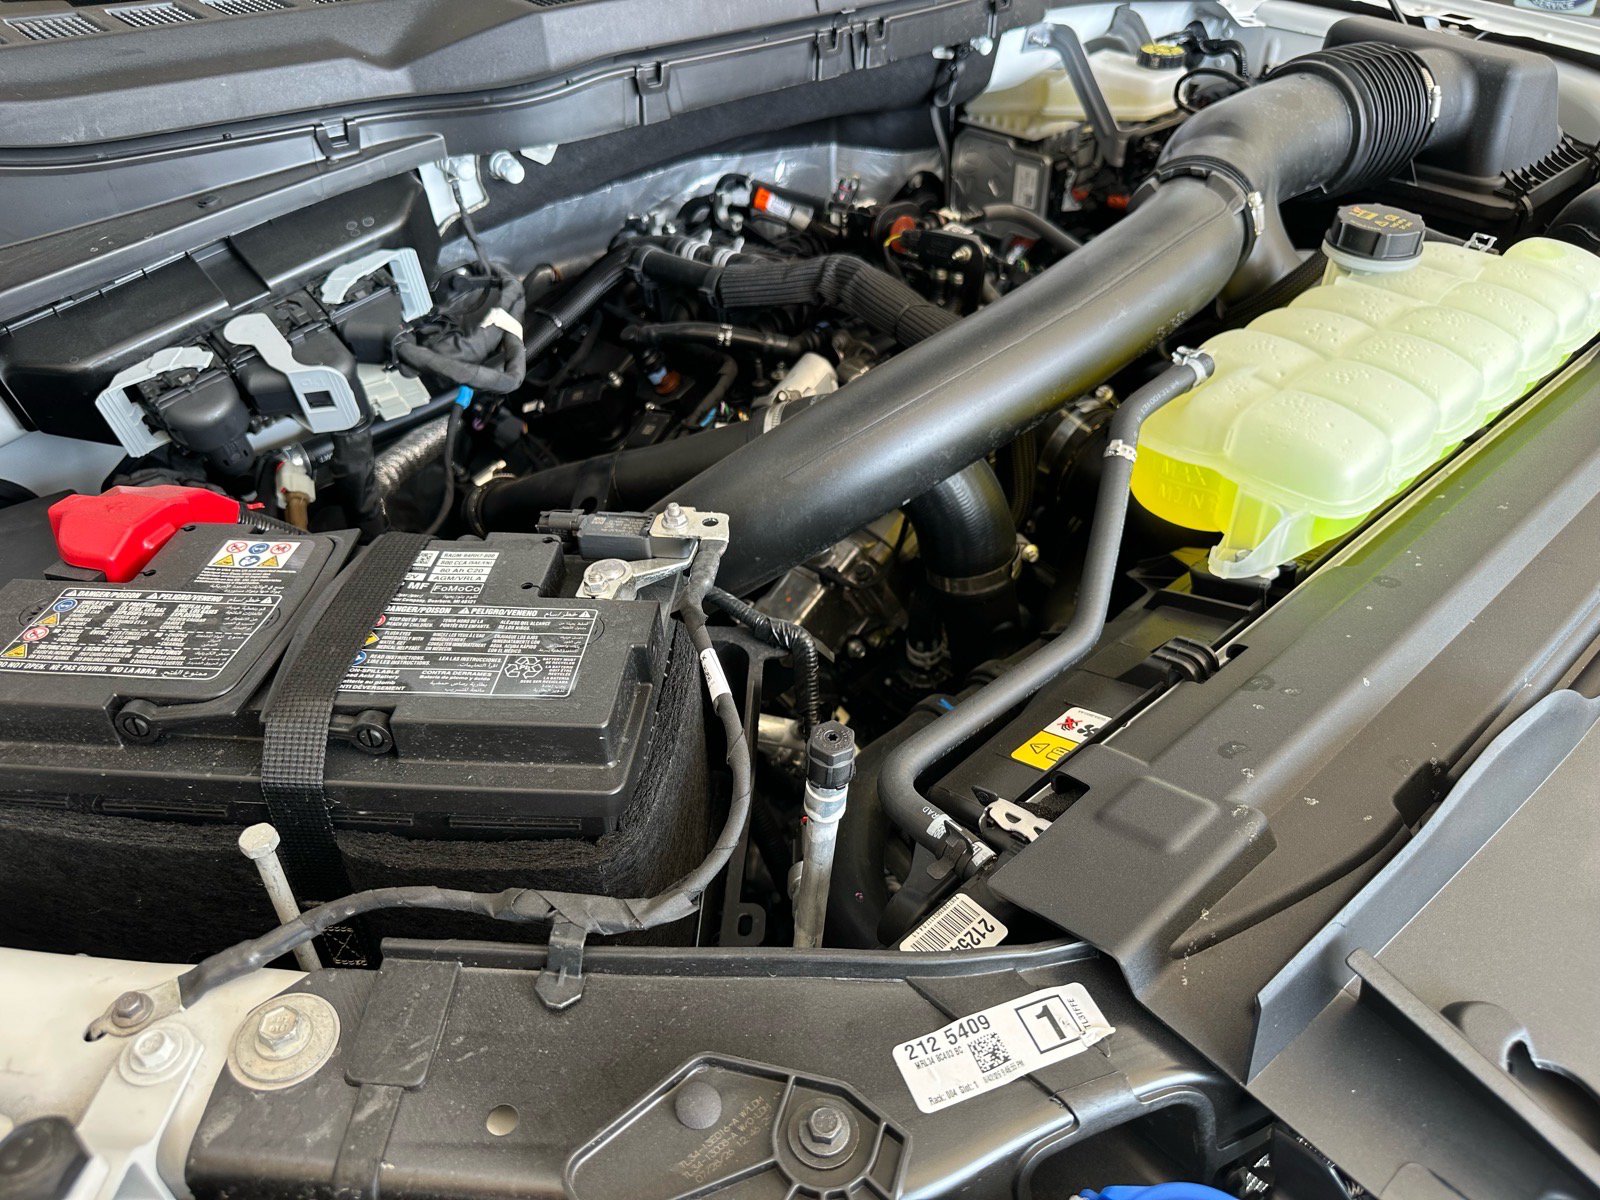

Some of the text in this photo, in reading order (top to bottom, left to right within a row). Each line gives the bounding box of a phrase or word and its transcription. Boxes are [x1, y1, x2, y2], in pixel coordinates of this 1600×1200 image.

[1161, 459, 1207, 486] MAX
[471, 608, 537, 616] PELIGRO/VENENO
[1035, 1004, 1067, 1041] 1
[904, 1015, 991, 1060] 212 5409
[928, 1093, 946, 1105] Rack:
